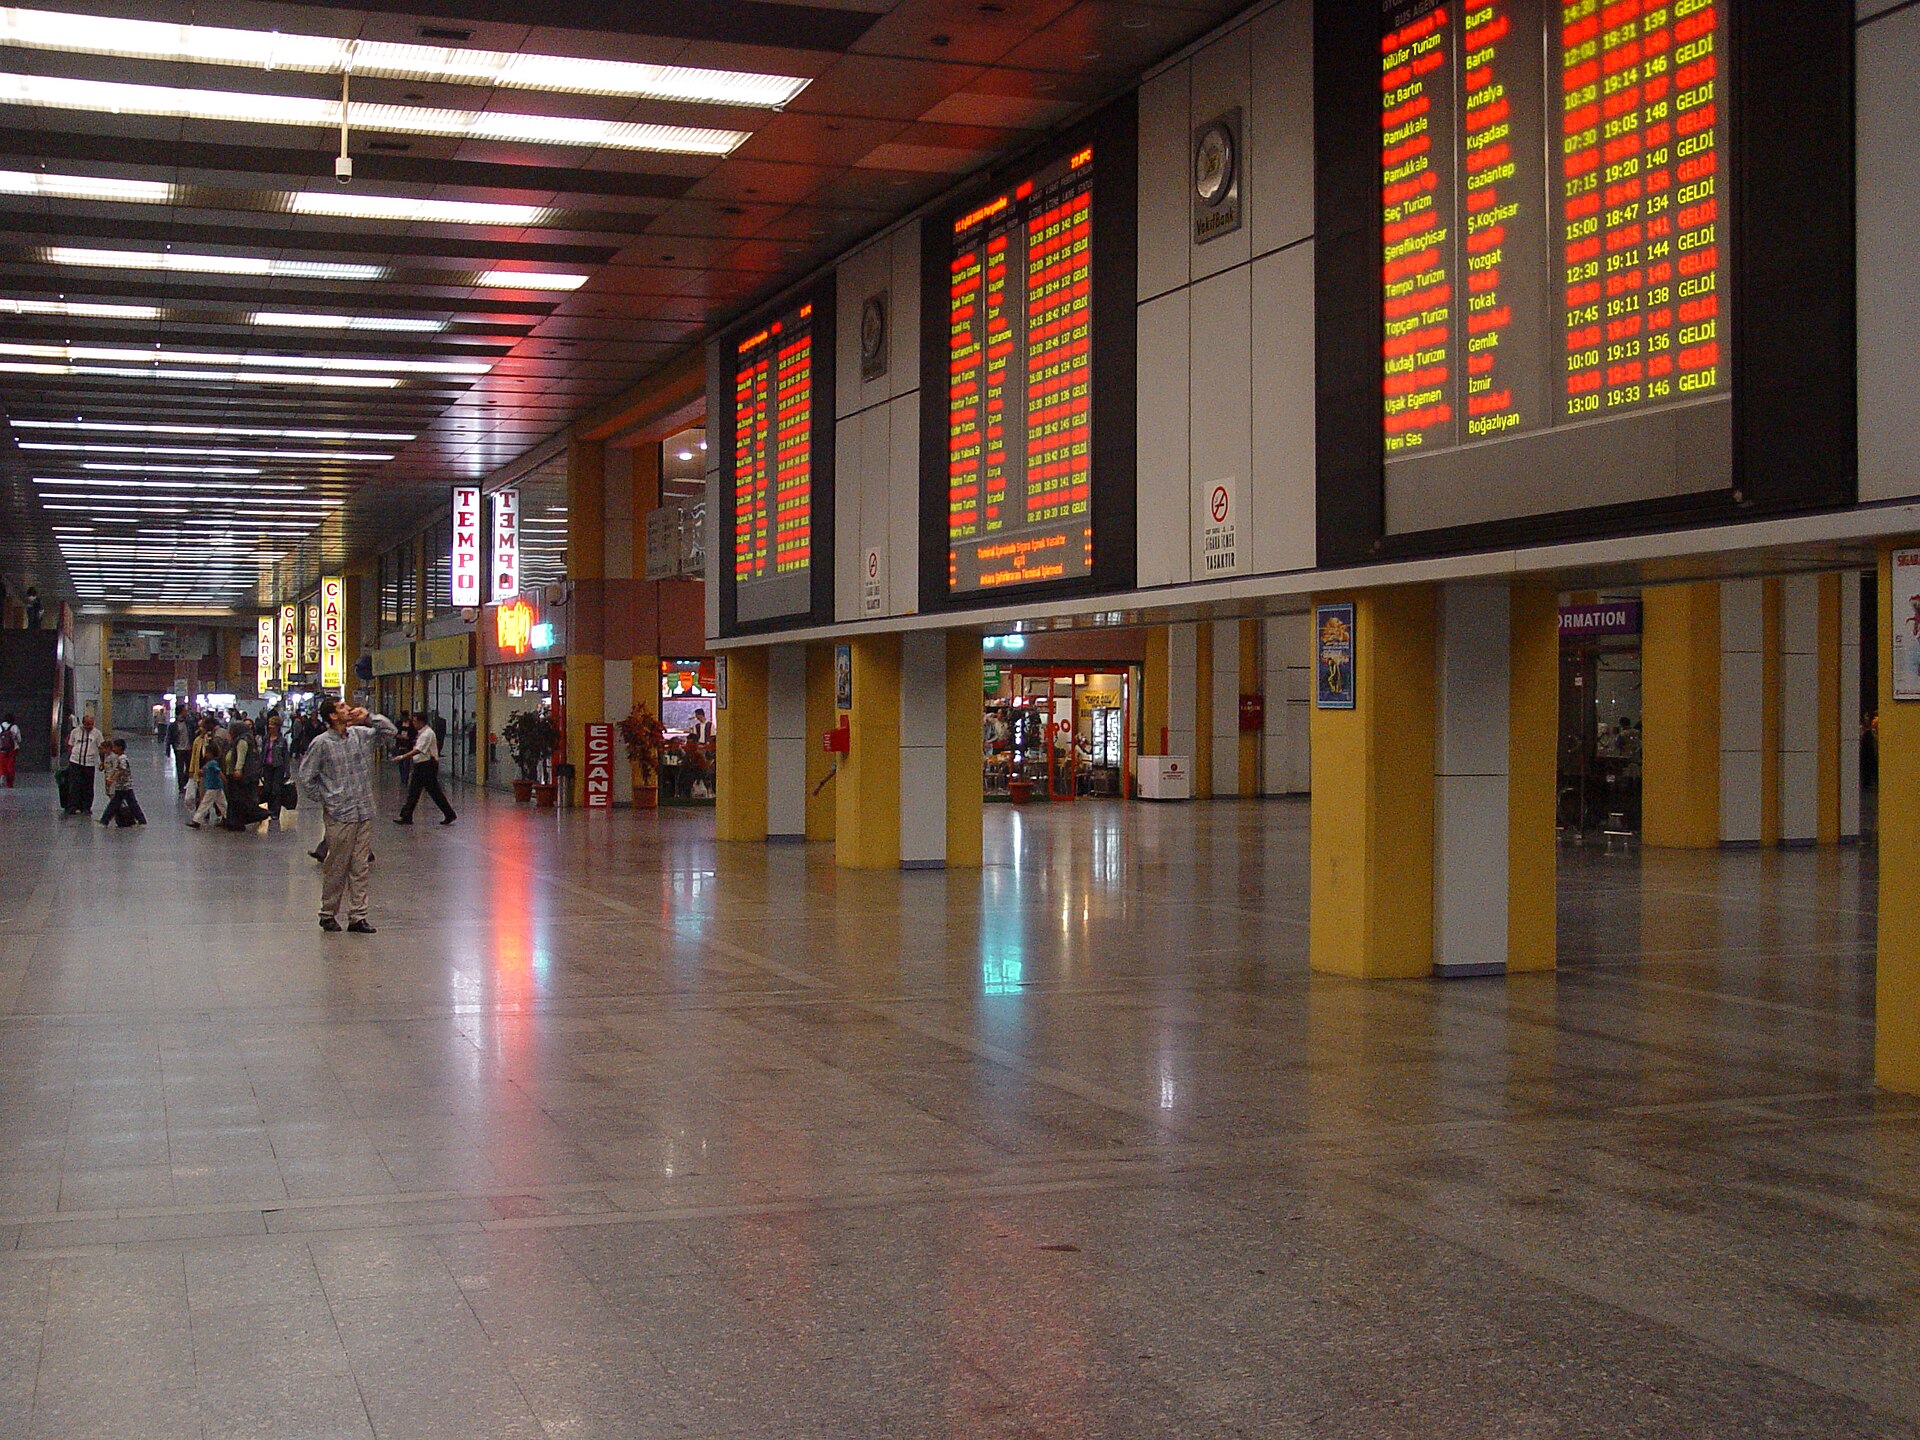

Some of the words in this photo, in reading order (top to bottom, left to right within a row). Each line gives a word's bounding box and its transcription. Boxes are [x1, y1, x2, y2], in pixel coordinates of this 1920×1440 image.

[1466, 8, 1492, 30] Bursa
[1603, 23, 1637, 49] 19:31
[1644, 9, 1668, 32] 139
[1383, 48, 1410, 71] Nilüfer
[1412, 34, 1441, 56] Turizm
[1466, 48, 1494, 70] Bartın
[1564, 85, 1597, 111] 10:30
[1604, 70, 1639, 95] 19:14
[1645, 56, 1668, 79] 146
[1675, 33, 1713, 64] GELDİ
[1383, 93, 1394, 108] Öz
[1397, 82, 1422, 102] Bartın
[1467, 85, 1504, 110] Antalya
[1564, 128, 1598, 153] 07:30
[1604, 112, 1638, 138] 19:05
[1645, 102, 1668, 123] 148
[1676, 81, 1714, 110] GELDİ
[1384, 117, 1427, 146] Pamukkale
[1467, 123, 1510, 150] Kuşadası
[1384, 156, 1428, 184] Pamukkale
[1467, 162, 1516, 190] Gaziantep
[1565, 172, 1598, 197] 17:15
[1605, 158, 1640, 183] 19:20
[1646, 148, 1668, 168] 140
[1677, 129, 1714, 157] GELDİ
[1384, 207, 1400, 222] Seç
[1403, 195, 1432, 214] Turizm
[1468, 203, 1519, 234] Ş.Koçhisar
[1566, 217, 1598, 240] 15:00
[1606, 203, 1639, 227] 18:47
[1647, 194, 1669, 214] 134
[1678, 176, 1714, 204] GELDİ
[1468, 248, 1502, 270] Yozgat
[1567, 261, 1599, 284] 12:30
[1606, 250, 1639, 272] 19:11
[1647, 240, 1670, 260] 144
[1678, 224, 1715, 250] GELDİ
[1384, 279, 1412, 297] Tempo
[1415, 269, 1445, 288] Turizm
[1468, 292, 1496, 312] Tokat
[1567, 305, 1598, 327] 17:45
[1607, 295, 1640, 316] 19:11
[1648, 287, 1669, 306] 138
[1679, 271, 1715, 297] GELDİ
[1384, 317, 1417, 336] Topçam
[1468, 332, 1498, 352] Gemlik
[1567, 350, 1599, 370] 10:00
[1607, 340, 1640, 361] 19:13
[1648, 333, 1670, 352] 136
[1679, 319, 1716, 344] GELDİ
[1384, 354, 1414, 375] Uludağ
[1416, 349, 1446, 365] Turizm
[1469, 376, 1491, 393] İzmir
[1567, 394, 1599, 414] 13:00
[1607, 385, 1640, 406] 19:33
[1648, 379, 1670, 398] 146
[1678, 367, 1717, 393] GELDİ
[1384, 396, 1404, 414] Uşak
[1406, 389, 1443, 409] Egemen
[1469, 413, 1520, 435] Boğazlıyan
[1384, 436, 1403, 450] Yeni
[1405, 433, 1423, 447] Ses
[457, 490, 475, 589] TEMPO
[1206, 552, 1235, 570] YASAKTIR
[588, 725, 609, 807] ECZANE
